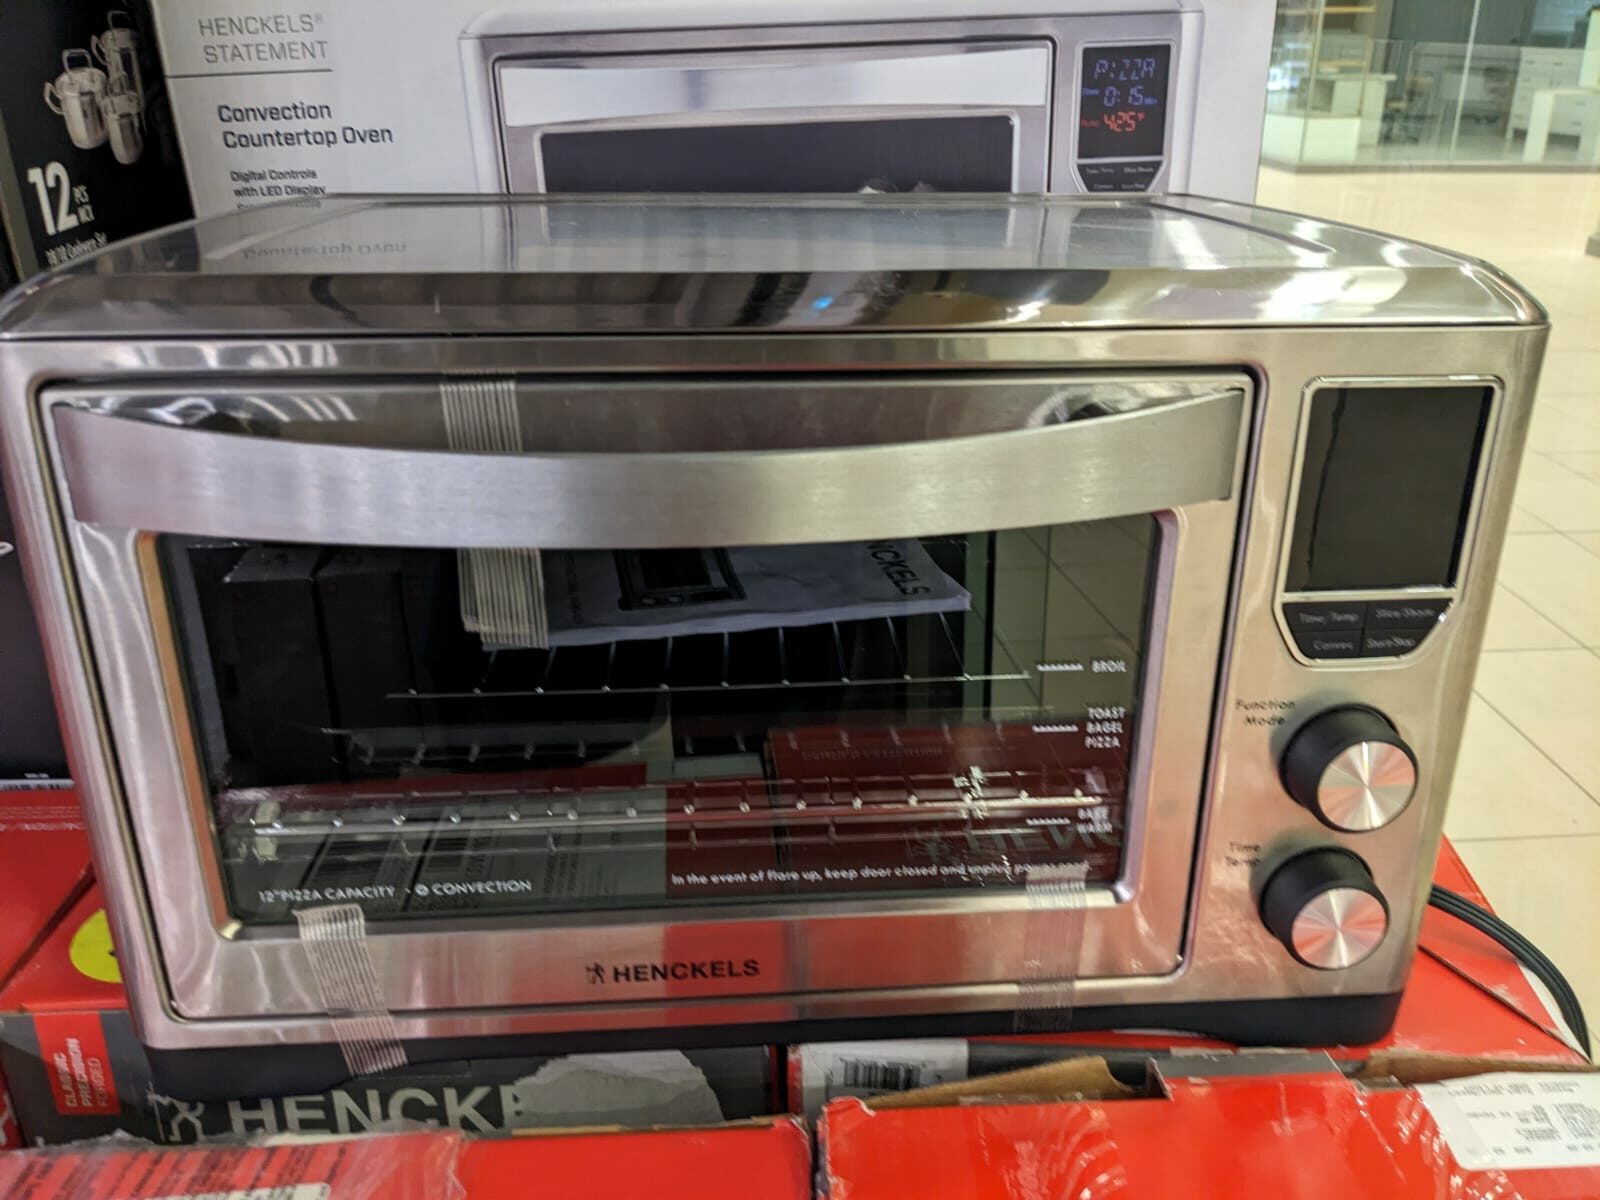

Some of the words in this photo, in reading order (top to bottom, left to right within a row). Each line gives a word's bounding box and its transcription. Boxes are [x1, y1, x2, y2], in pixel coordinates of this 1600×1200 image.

[203, 41, 328, 63] STATEMENT
[217, 101, 332, 123] Convection
[222, 128, 338, 148] Countertop
[342, 126, 393, 144] Oven
[230, 169, 267, 183] Digital
[268, 168, 317, 181] Controls
[27, 161, 79, 236] 12
[233, 185, 258, 198] with
[260, 185, 283, 197] LED
[284, 184, 326, 199] Display
[1091, 659, 1127, 673] BROIL
[1235, 698, 1296, 711] Function
[1087, 706, 1127, 720] TOAST
[1244, 715, 1286, 726] Mode
[1086, 721, 1124, 734] BAGEL
[1085, 736, 1120, 749] PIZZA
[671, 873, 685, 886] In
[686, 872, 708, 885] the
[710, 871, 748, 884] event
[750, 869, 764, 882] of
[767, 868, 799, 882] flare
[824, 866, 858, 881] keep
[860, 865, 891, 878] door
[895, 864, 938, 877] closed
[940, 863, 966, 876] and
[324, 884, 396, 900] CAPACITY
[432, 879, 533, 896] CONVECTION
[612, 958, 760, 983] HENCKELS
